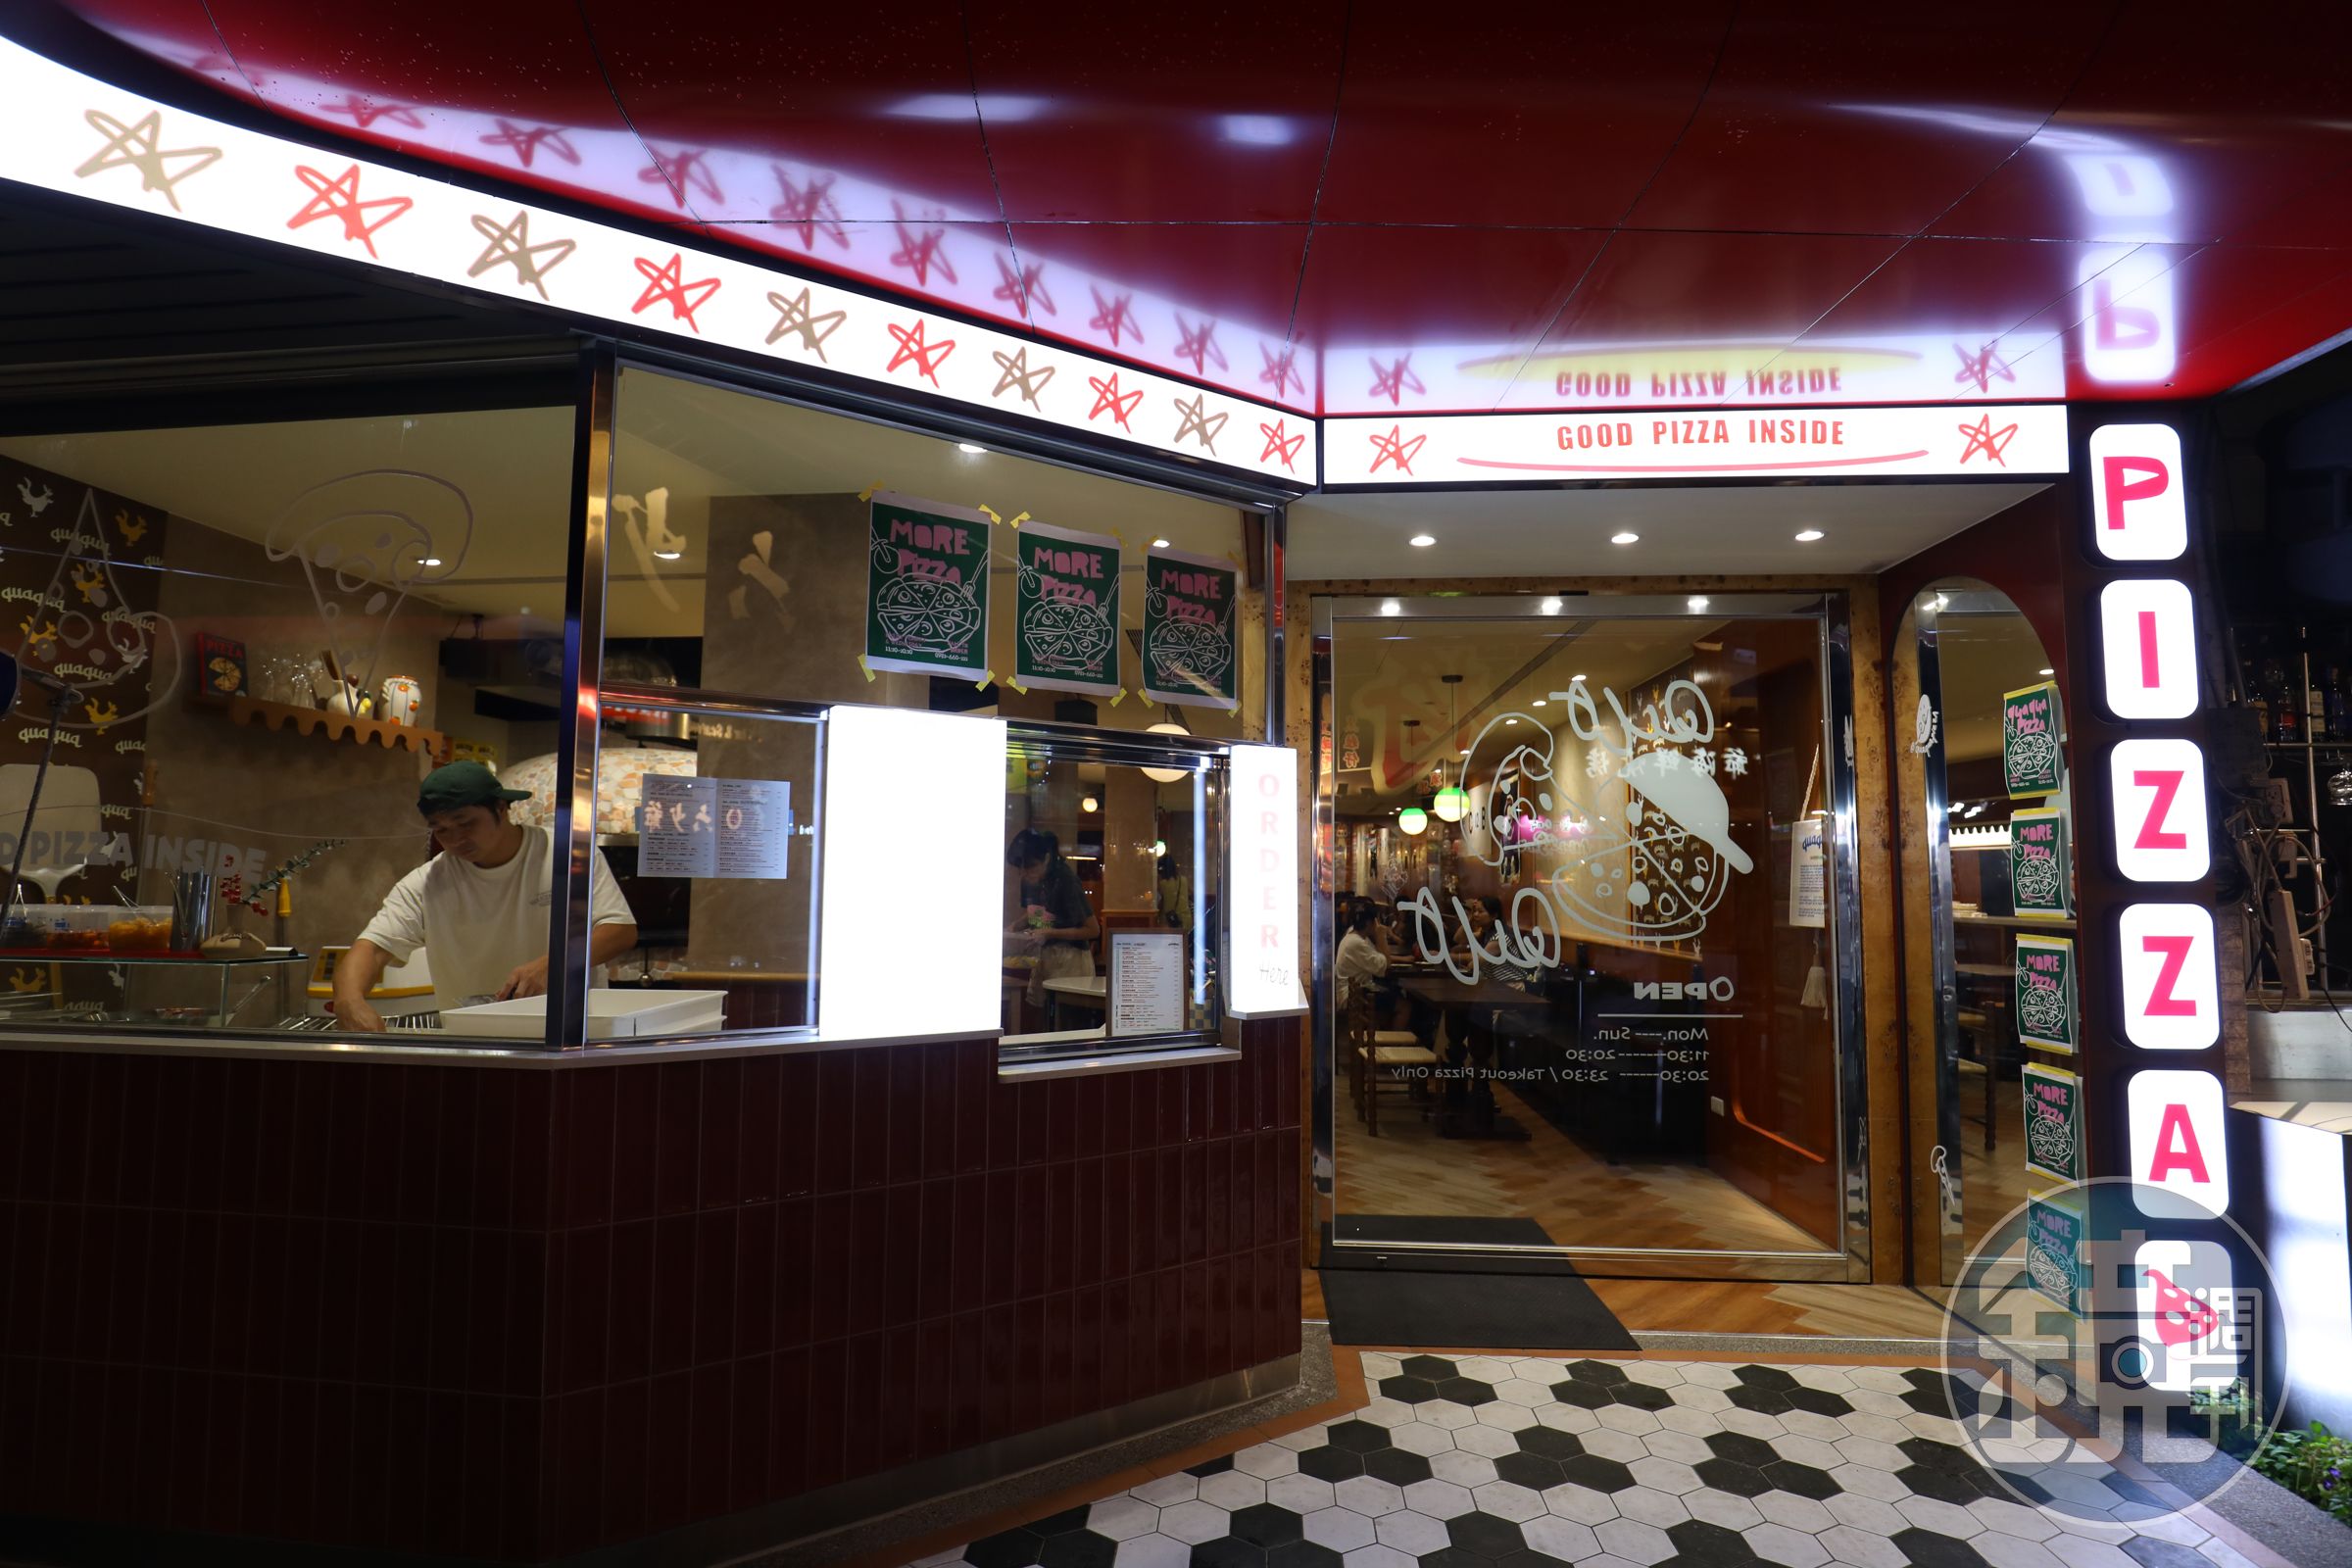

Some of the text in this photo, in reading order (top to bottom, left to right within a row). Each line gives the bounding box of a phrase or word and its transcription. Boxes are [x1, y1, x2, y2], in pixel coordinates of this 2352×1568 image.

[1557, 418, 1843, 450] GOOD PIZZA INSIDE
[890, 518, 970, 556] MORE
[897, 549, 961, 585] PIZZA
[1034, 547, 1104, 579] MORE
[1041, 574, 1097, 609] PIZZA
[1160, 569, 1222, 600] MORE
[1166, 595, 1216, 626] PIZZA
[2020, 824, 2054, 842] MORE
[2104, 457, 2209, 1183] PIZZA
[30, 830, 134, 867] PIZZA
[144, 835, 268, 882] INSIDE
[1258, 773, 1280, 950] ORDER
[1259, 963, 1289, 986] Here
[2027, 955, 2060, 972] MORE
[2034, 1082, 2069, 1106] MORE
[2037, 1209, 2072, 1238] MORE
